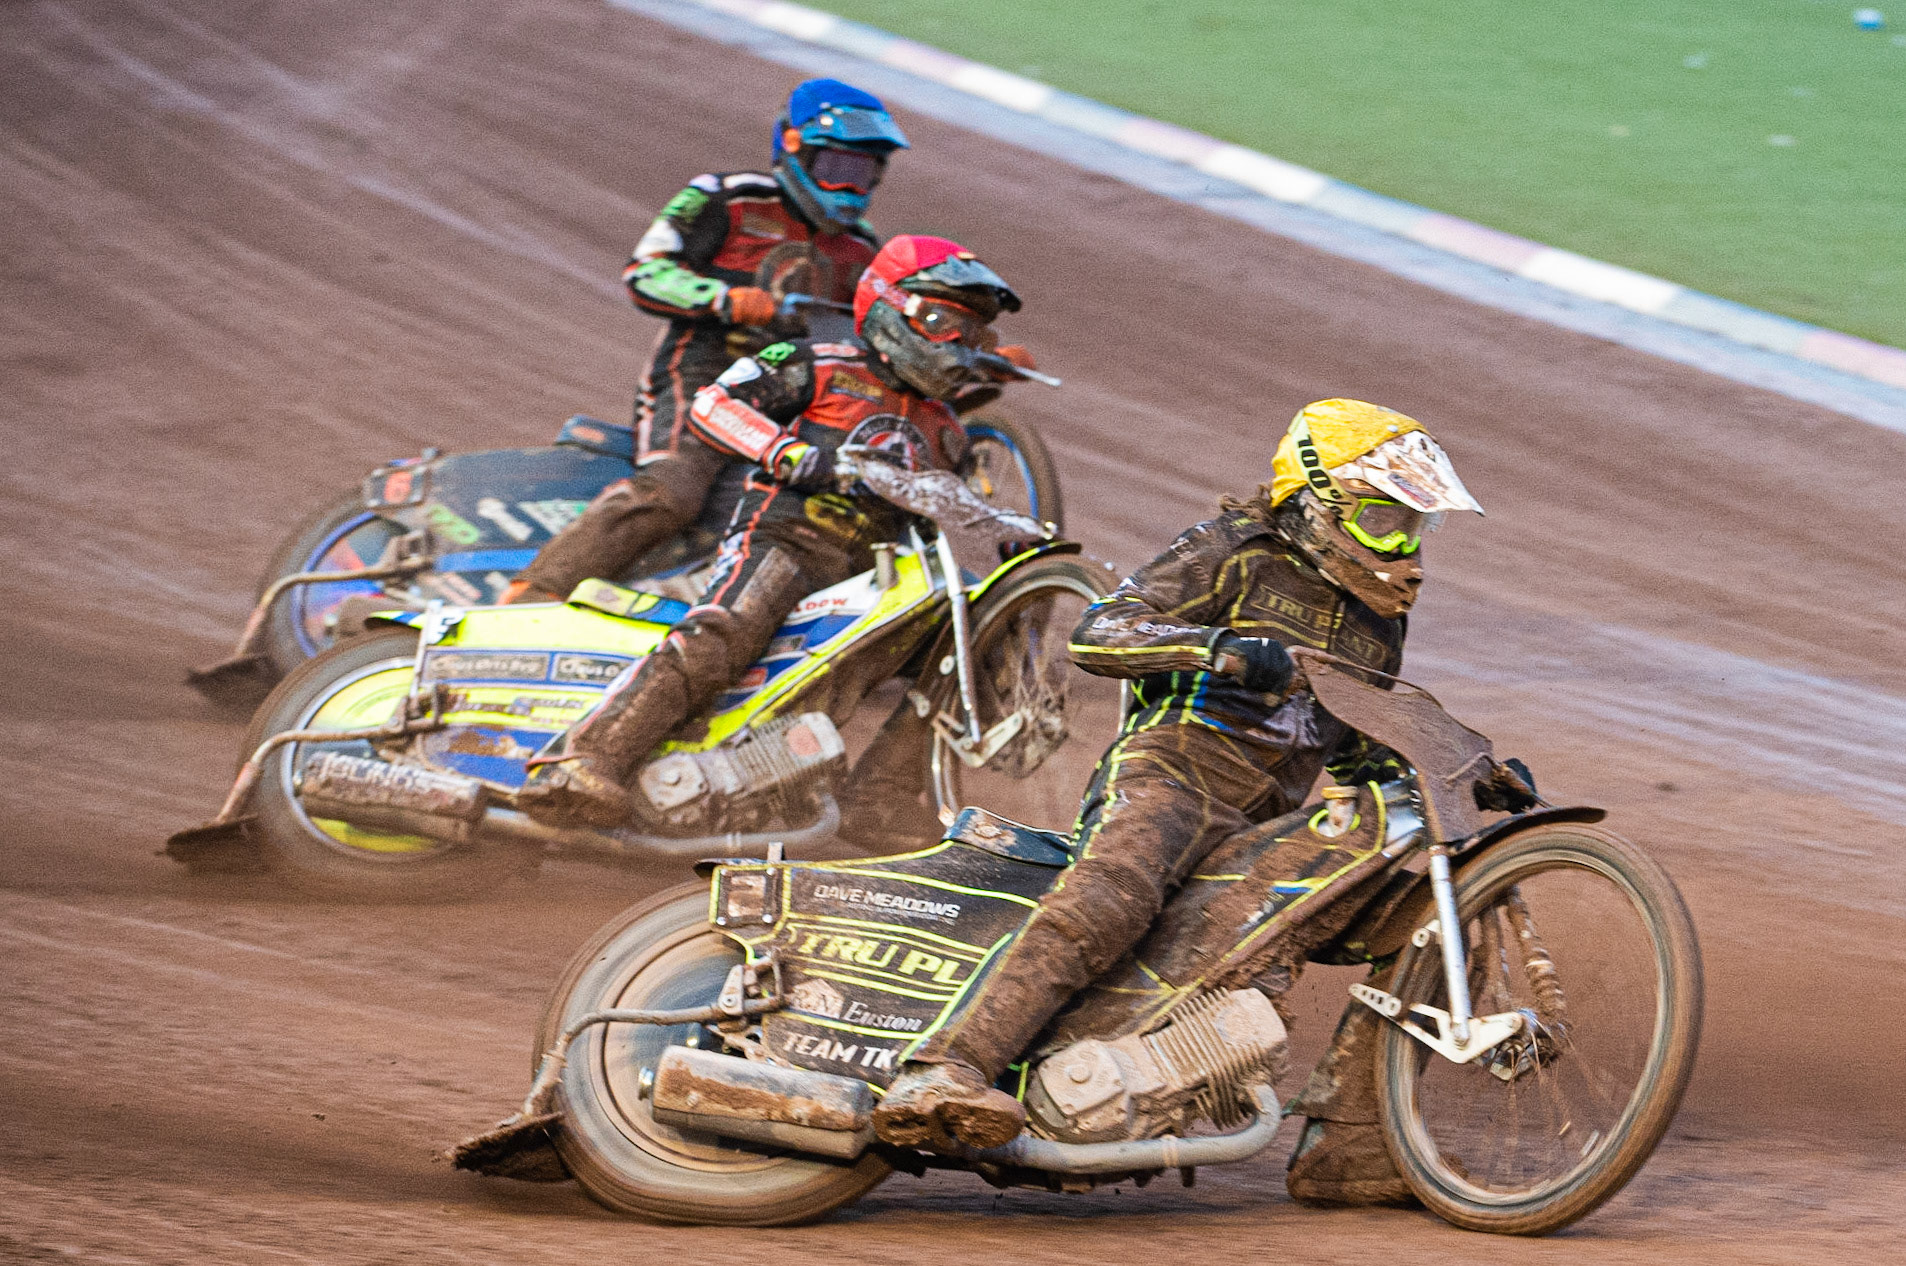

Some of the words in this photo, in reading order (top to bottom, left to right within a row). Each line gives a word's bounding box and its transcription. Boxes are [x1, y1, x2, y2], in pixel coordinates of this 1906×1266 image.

[814, 885, 863, 903] DAVE
[863, 890, 961, 918] MEADOWS
[798, 932, 900, 968] TRU
[783, 1031, 859, 1063] TEAM
